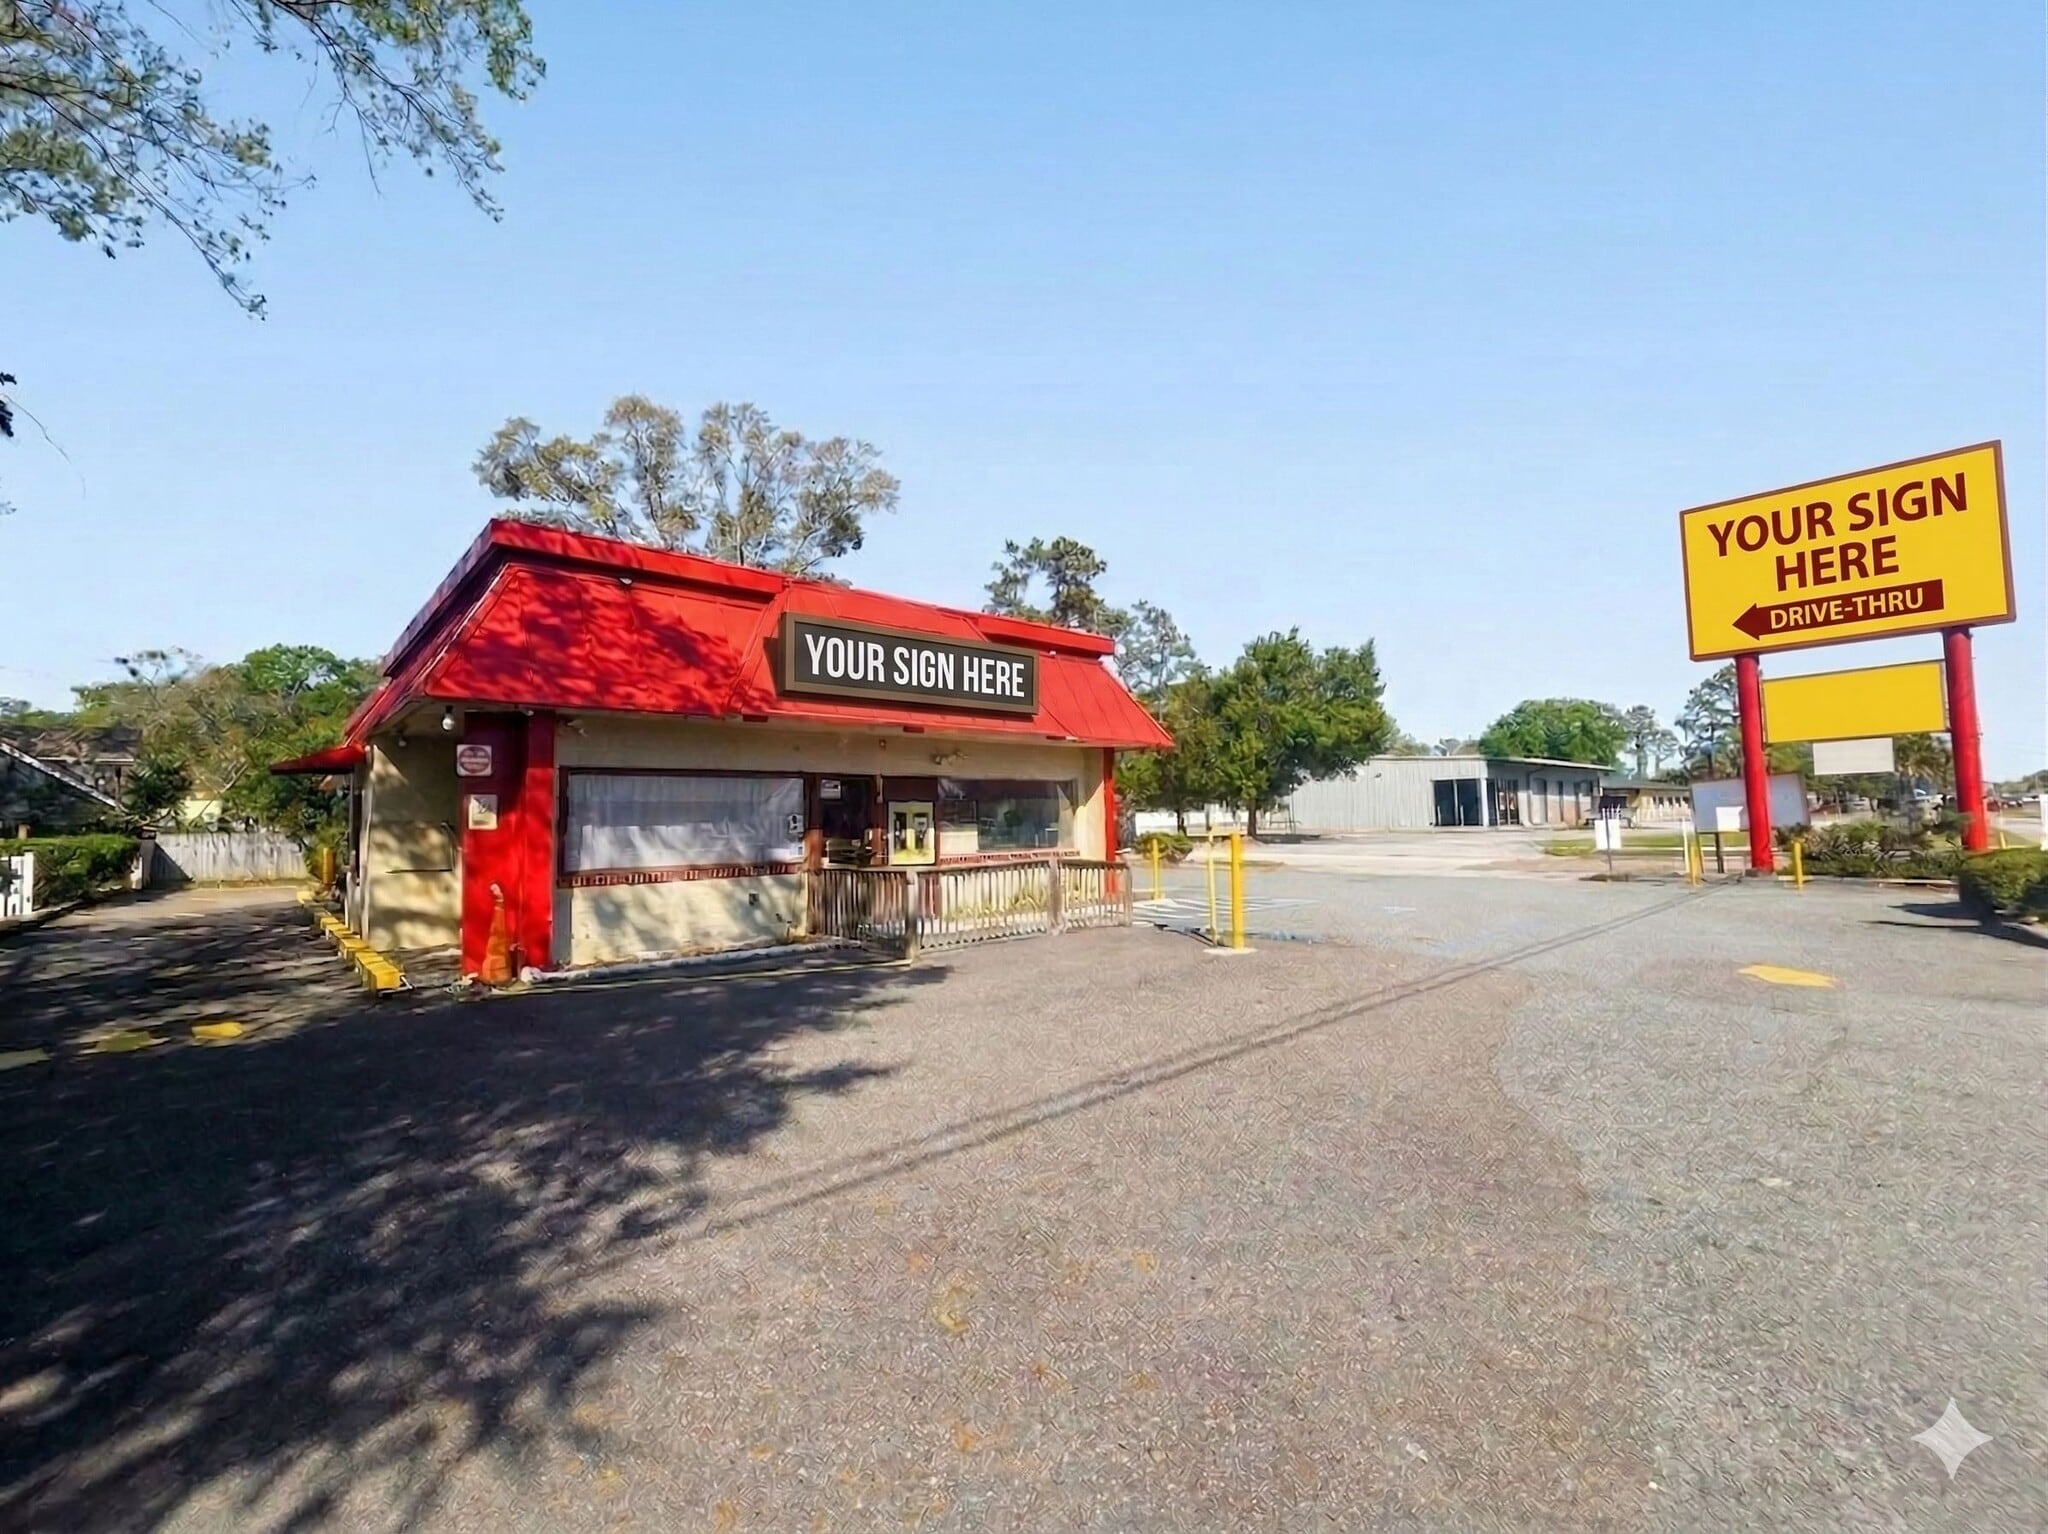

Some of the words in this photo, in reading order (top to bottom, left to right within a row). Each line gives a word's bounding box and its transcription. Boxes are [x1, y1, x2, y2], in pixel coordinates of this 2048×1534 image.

[1707, 501, 1836, 557] YOUR
[1847, 472, 1968, 532] SIGN
[1775, 535, 1900, 592] HERE
[1770, 587, 1924, 630] DRIVE-THRU
[804, 633, 886, 683] YOUR
[893, 646, 955, 690] SIGN
[963, 655, 1025, 698] HERE
